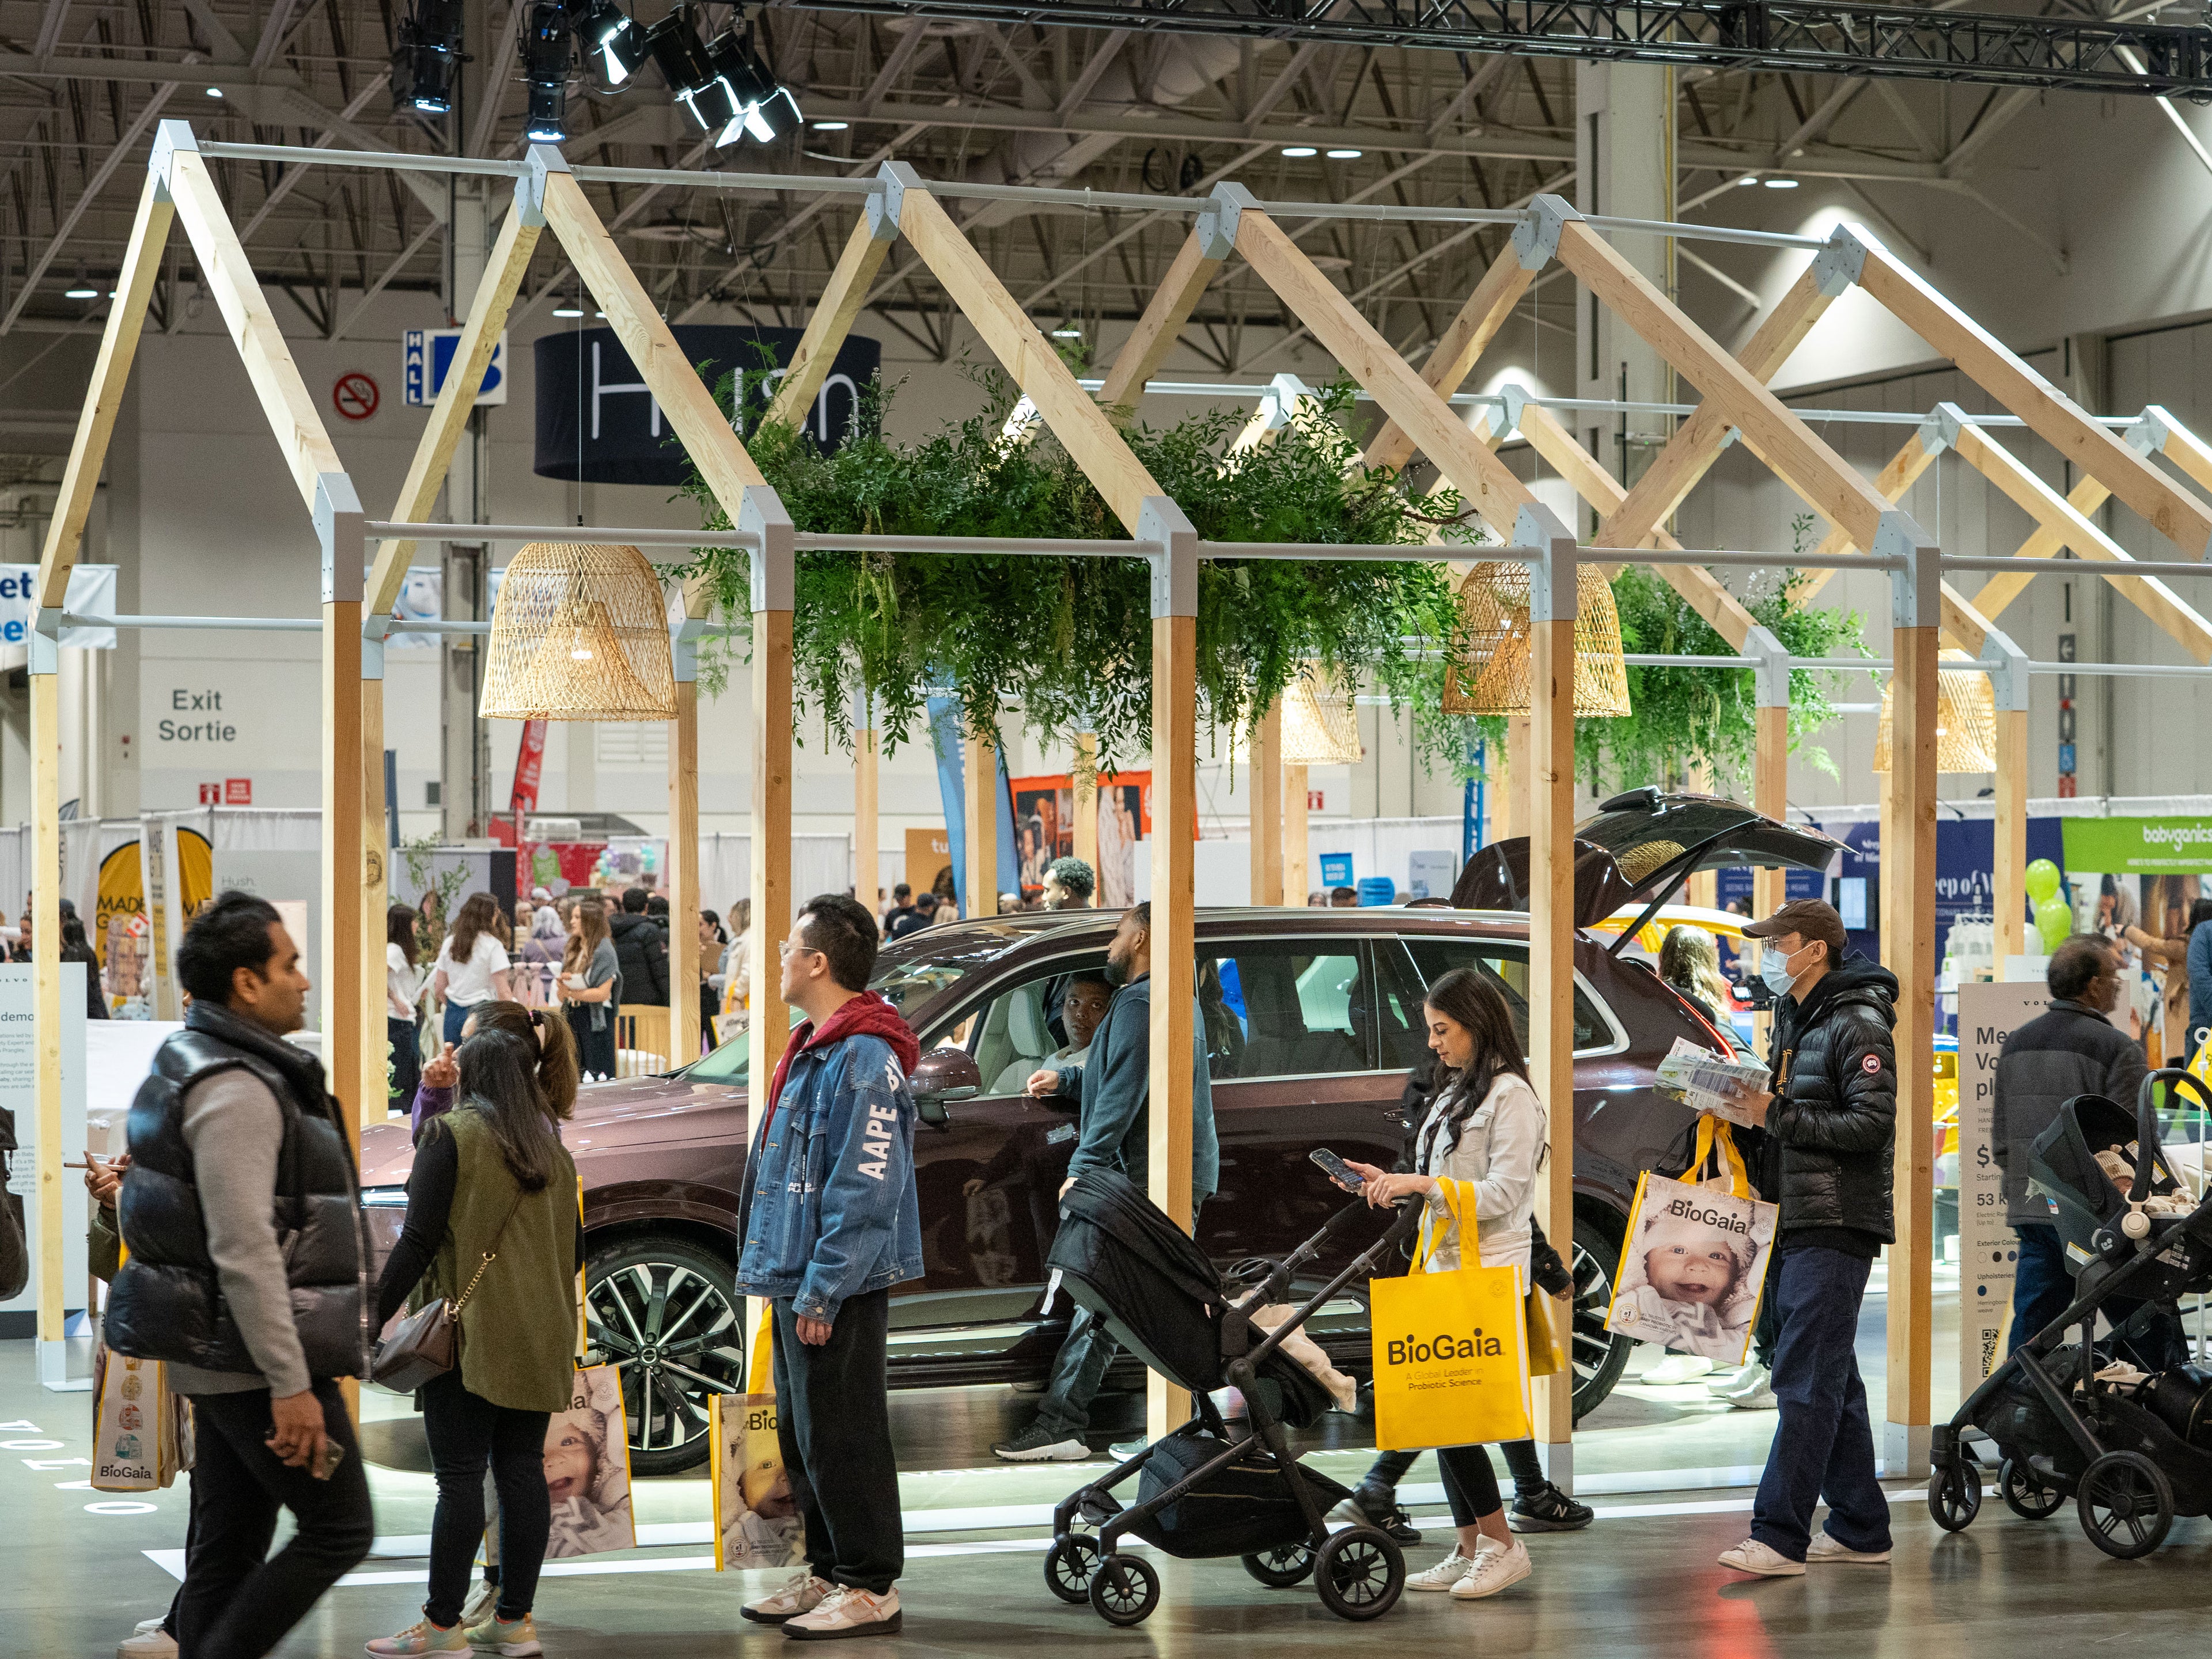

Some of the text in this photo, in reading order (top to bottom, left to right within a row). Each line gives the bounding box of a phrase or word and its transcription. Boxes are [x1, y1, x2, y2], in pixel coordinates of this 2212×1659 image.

[408, 333, 422, 403] HALL
[0, 572, 32, 599] et
[173, 689, 222, 710] Exit
[160, 720, 236, 741] Sortie
[858, 1104, 897, 1180] AAPE
[1977, 1192, 2008, 1206] 53 k
[1671, 1199, 1747, 1234] BioGaia
[1977, 1272, 2015, 1280] Upholsteries
[1388, 1327, 1502, 1366] BioGaia
[1408, 1378, 1482, 1391] Probiotic Science
[1414, 1370, 1441, 1380] Global
[1444, 1368, 1473, 1378] Leader
[749, 1410, 778, 1431] Bio
[100, 1464, 152, 1479] BioGaia
